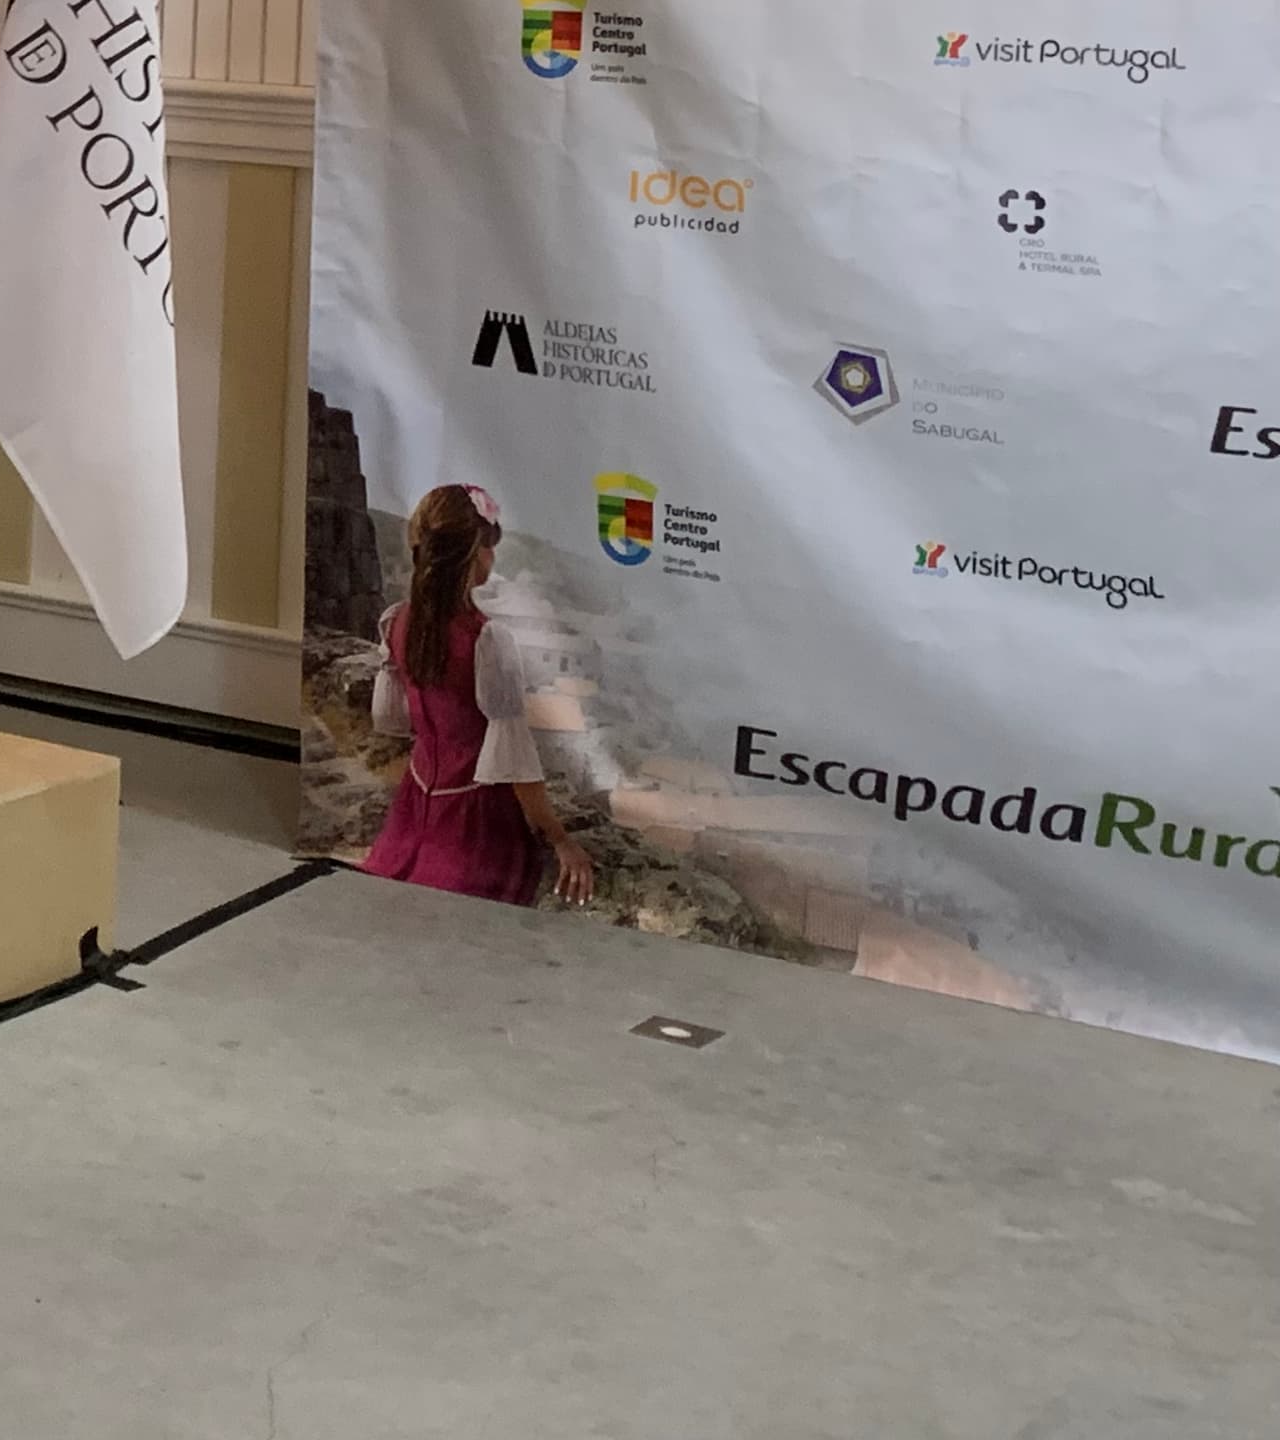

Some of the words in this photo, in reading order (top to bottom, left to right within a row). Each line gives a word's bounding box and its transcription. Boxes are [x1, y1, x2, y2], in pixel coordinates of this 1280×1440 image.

[593, 12, 643, 27] Turismo
[593, 26, 635, 40] Centro
[592, 40, 647, 58] Portugal
[976, 37, 1033, 63] visit
[1039, 39, 1187, 84] Portugal
[634, 213, 740, 234] publicidad
[544, 320, 618, 345] ALDEIAS
[543, 340, 649, 369] HISTÓRICAS
[560, 363, 656, 393] PORTUGAL
[912, 419, 1005, 444] SABUGAL
[664, 504, 717, 522] Turismo
[664, 518, 708, 535] Centro
[664, 532, 720, 553] Portugal
[954, 551, 1012, 580] visit
[1018, 557, 1165, 609] Portugal
[734, 725, 1280, 877] EscapadaRura
